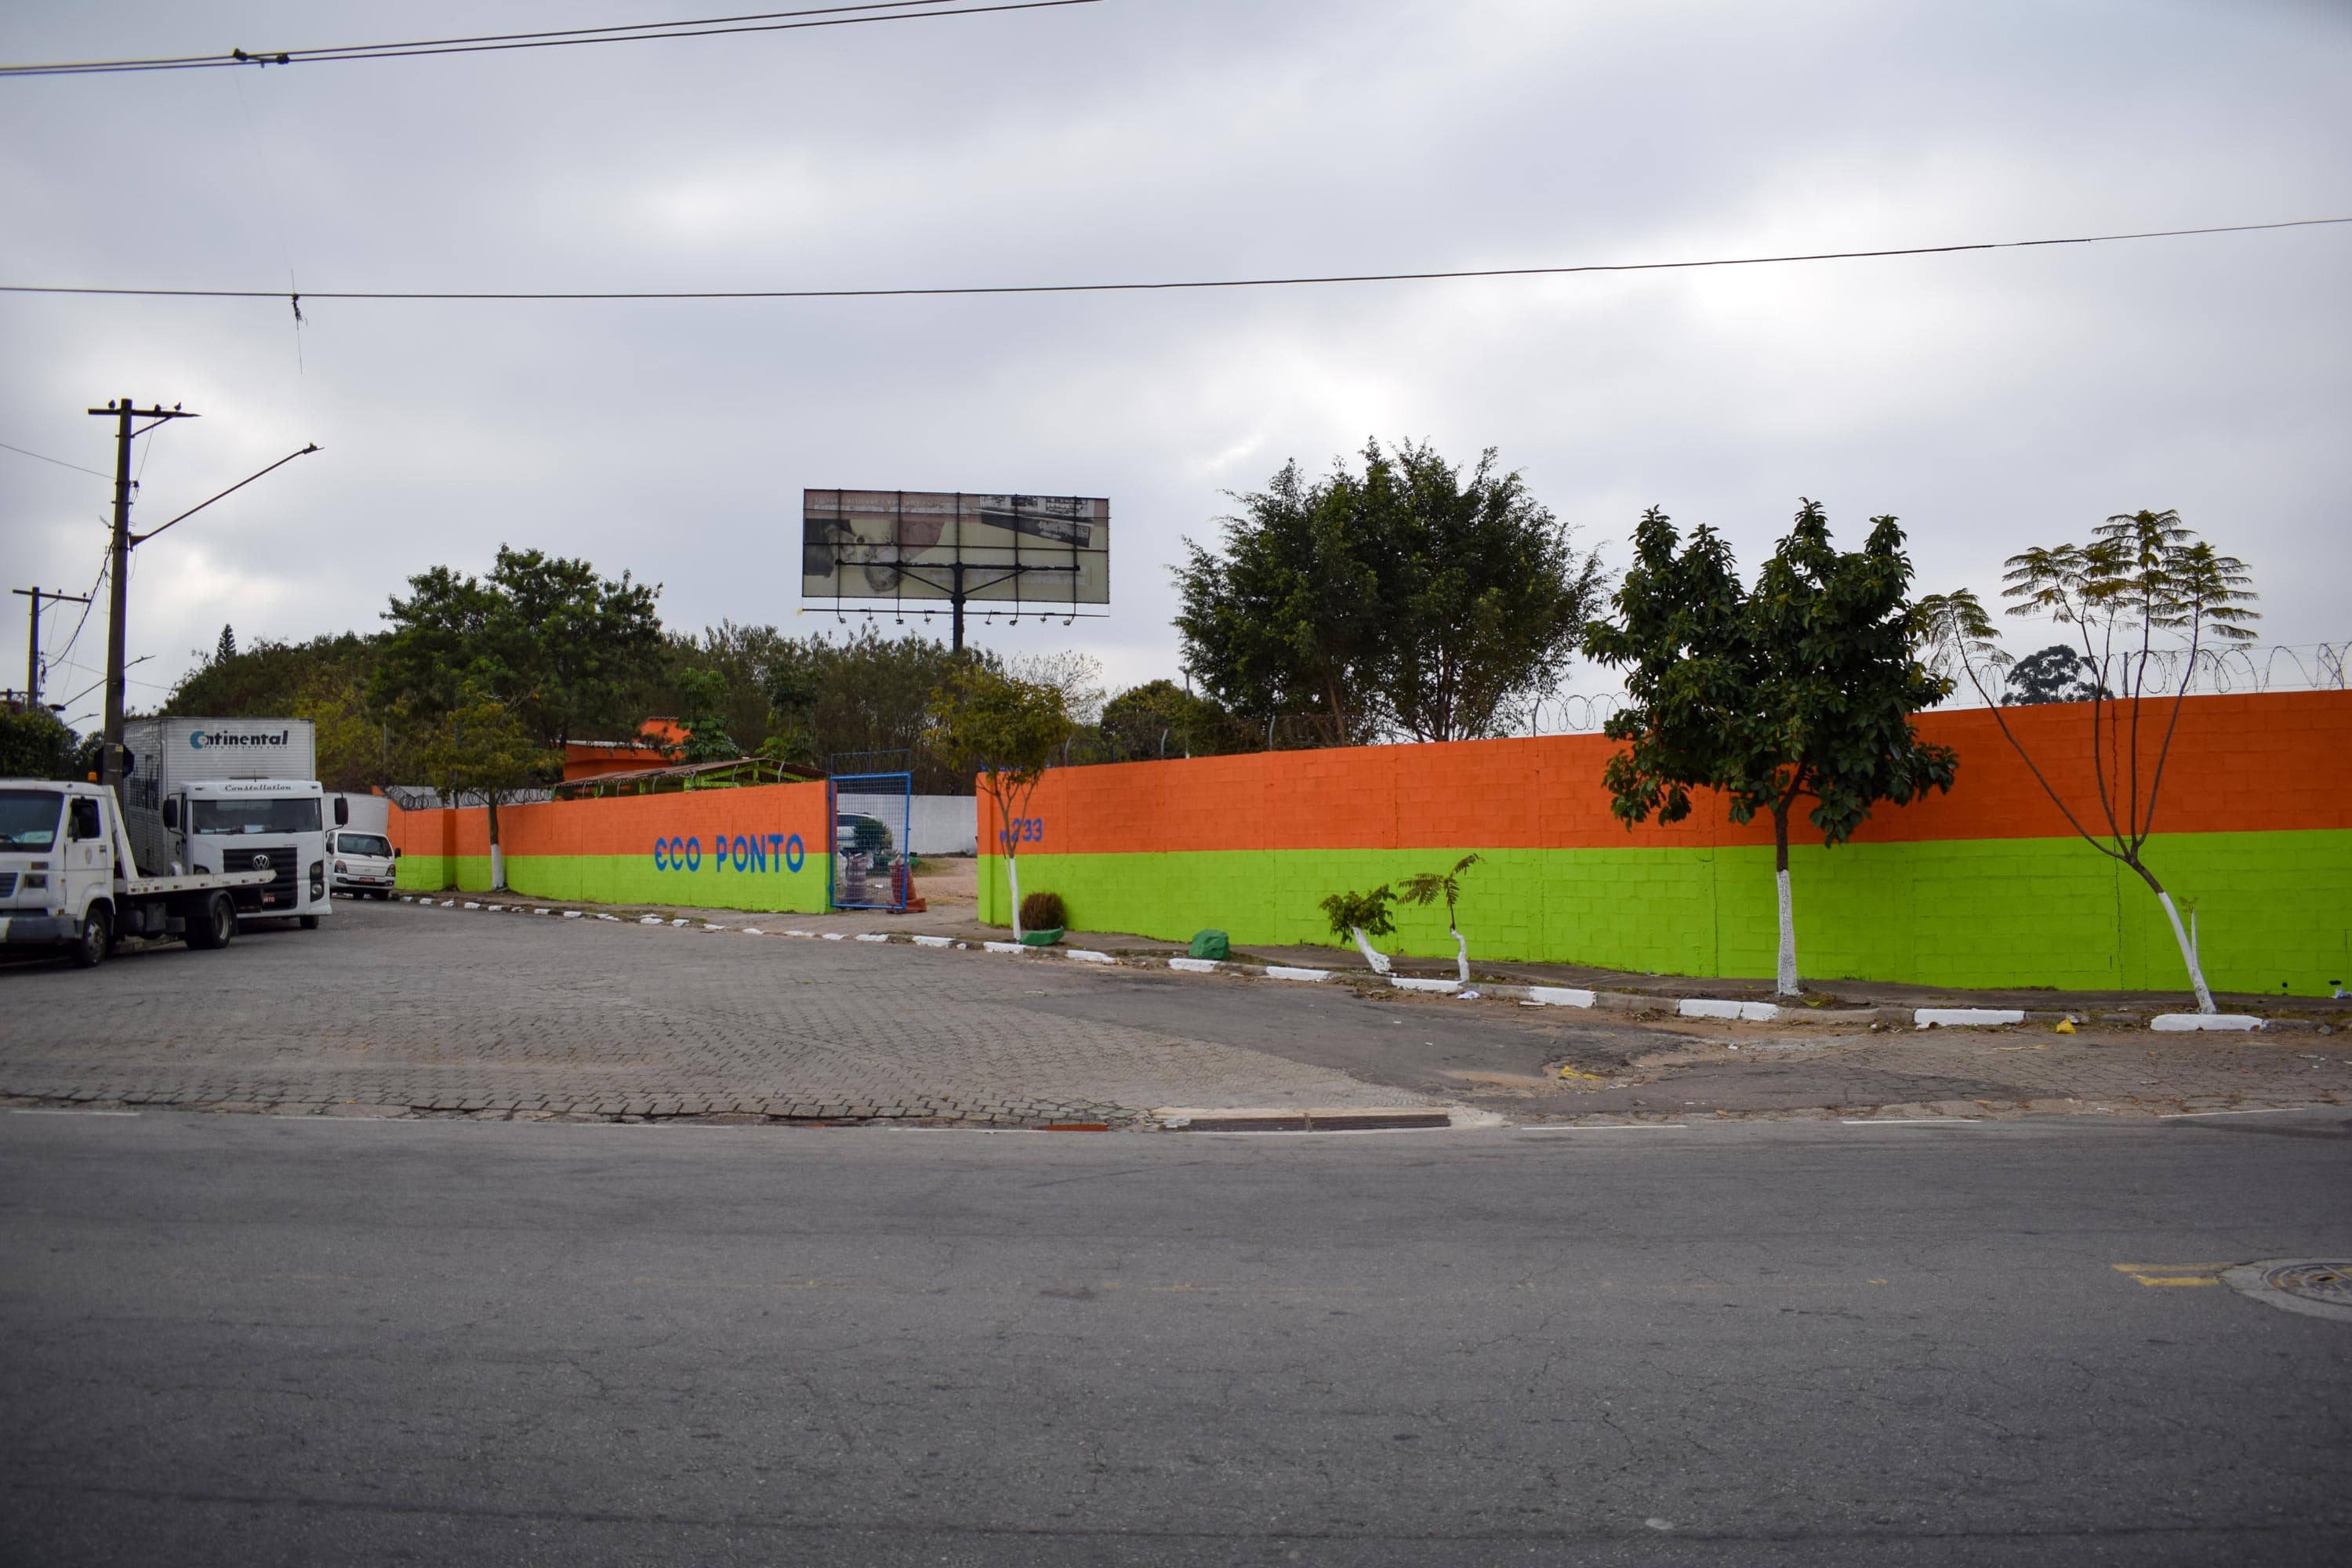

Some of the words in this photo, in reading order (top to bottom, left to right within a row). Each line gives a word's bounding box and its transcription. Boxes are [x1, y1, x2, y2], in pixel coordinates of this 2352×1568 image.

[1011, 818, 1044, 841] 233
[655, 837, 701, 872] ECO
[717, 833, 804, 873] PONTO
